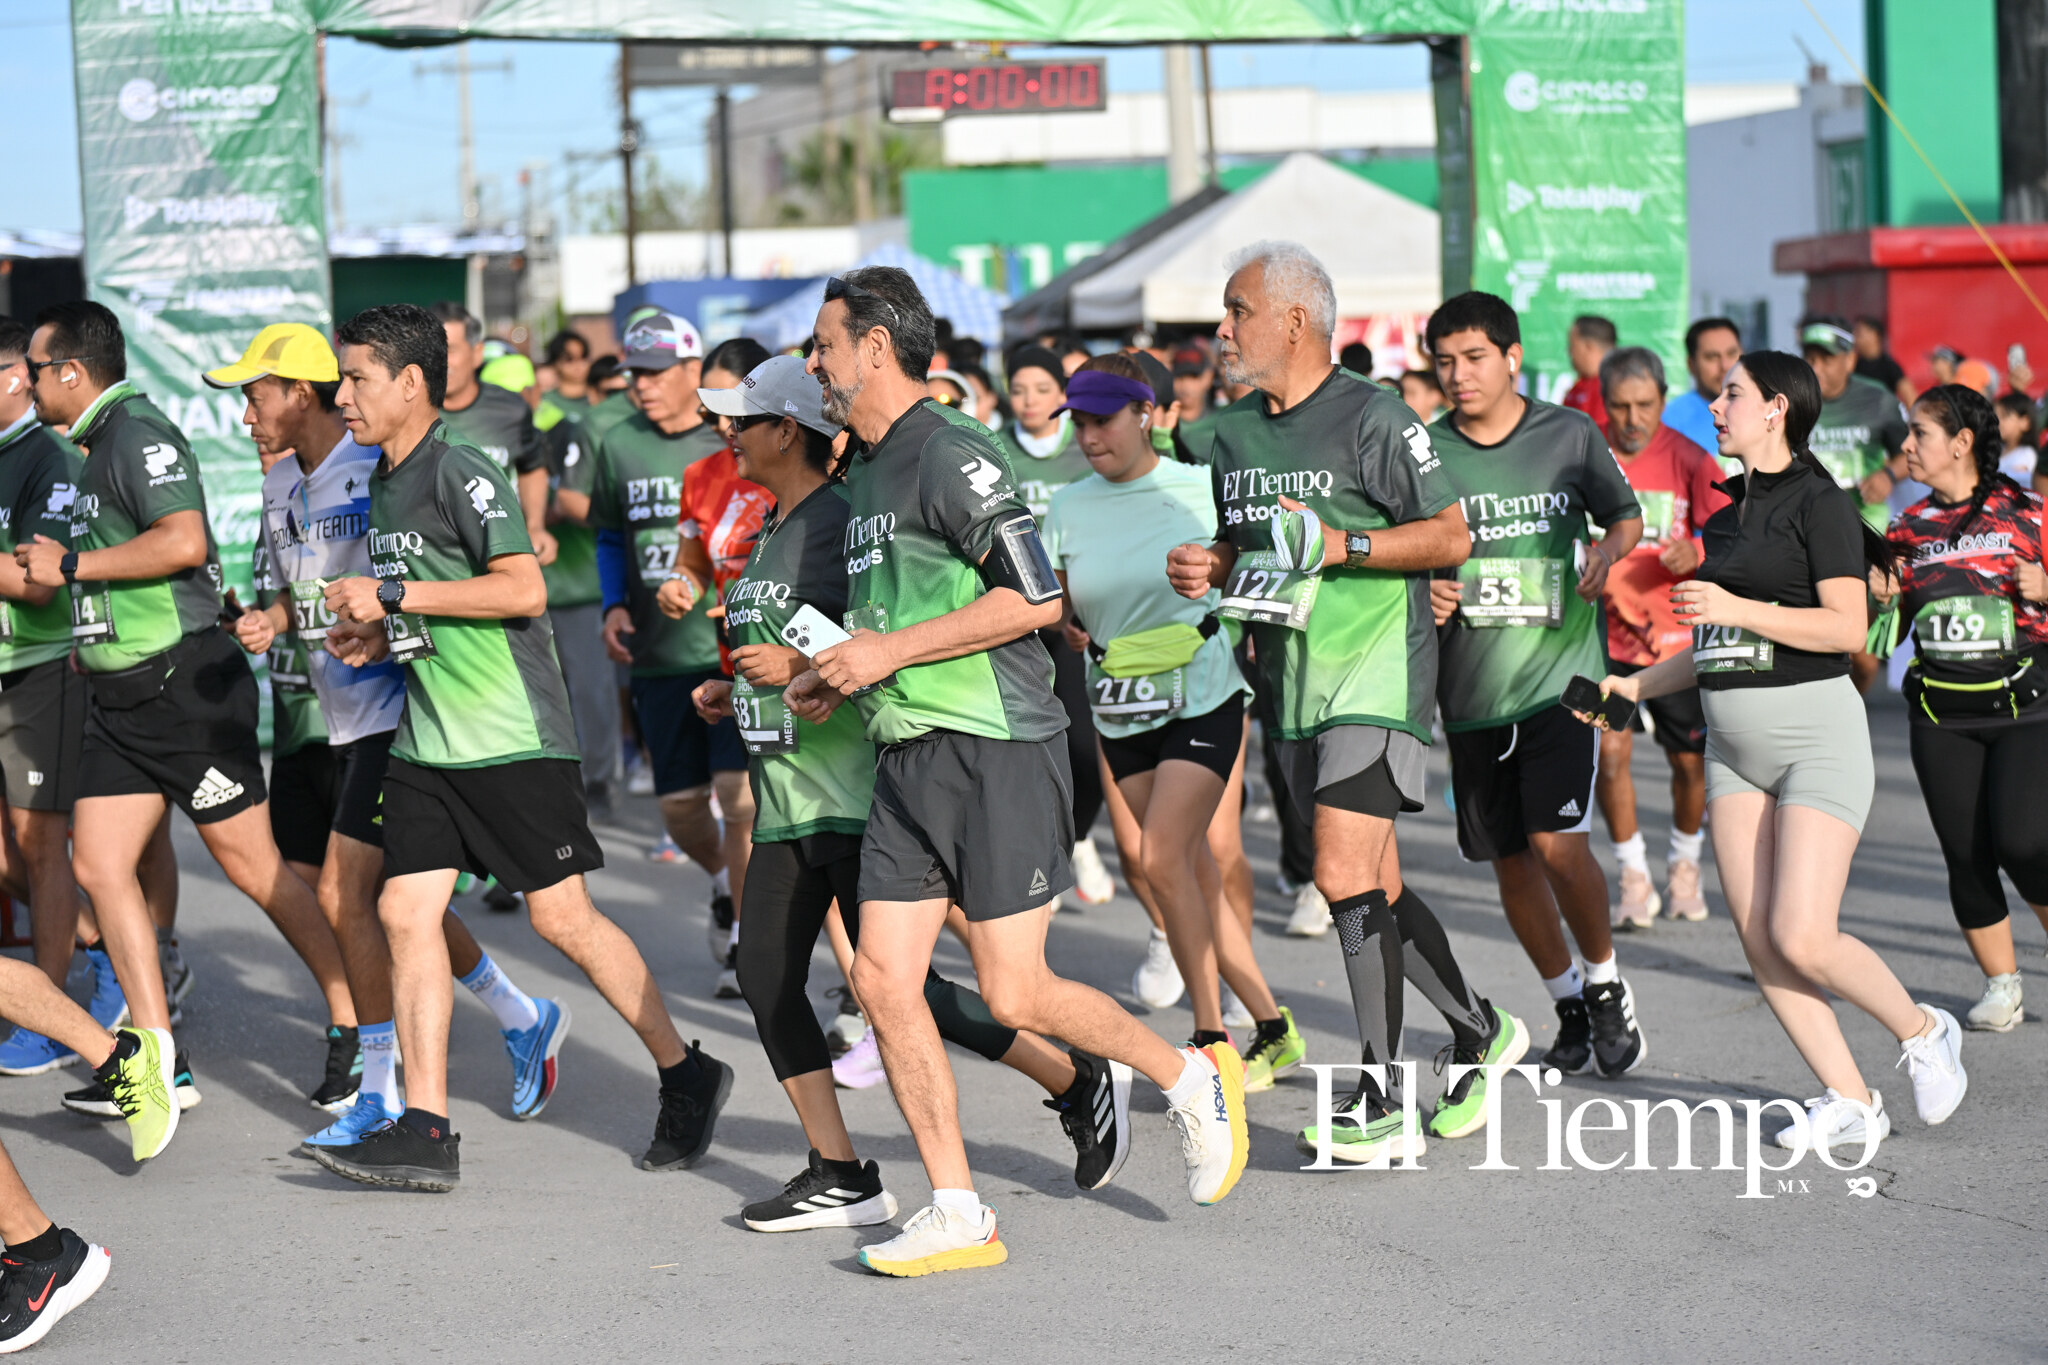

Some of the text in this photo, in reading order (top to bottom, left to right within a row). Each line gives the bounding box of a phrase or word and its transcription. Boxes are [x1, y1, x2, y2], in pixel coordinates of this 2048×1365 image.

[1541, 79, 1648, 102] cimaco
[162, 195, 279, 226] Totalplay
[1537, 183, 1647, 215] Totalplay
[627, 478, 649, 504] El
[1223, 468, 1333, 502] El Tiempo
[1470, 492, 1569, 521] Tiempo
[315, 513, 362, 541] TEAM
[849, 512, 896, 549] Tiempo
[1478, 519, 1551, 542] todos
[368, 528, 423, 558] Tiempo
[373, 560, 410, 580] todos
[1233, 570, 1289, 599] 127
[730, 577, 791, 606] Tiempo
[1479, 577, 1522, 606] 53
[1551, 574, 1560, 620] MEDALLA
[728, 605, 763, 627] todos
[1929, 614, 1985, 642] 169
[1698, 623, 1742, 650] 120
[1096, 675, 1156, 704] 276
[191, 782, 245, 810] adidas
[1558, 809, 1582, 817] adidas
[1028, 885, 1049, 897] Reebok
[1212, 1073, 1228, 1123] HOKA
